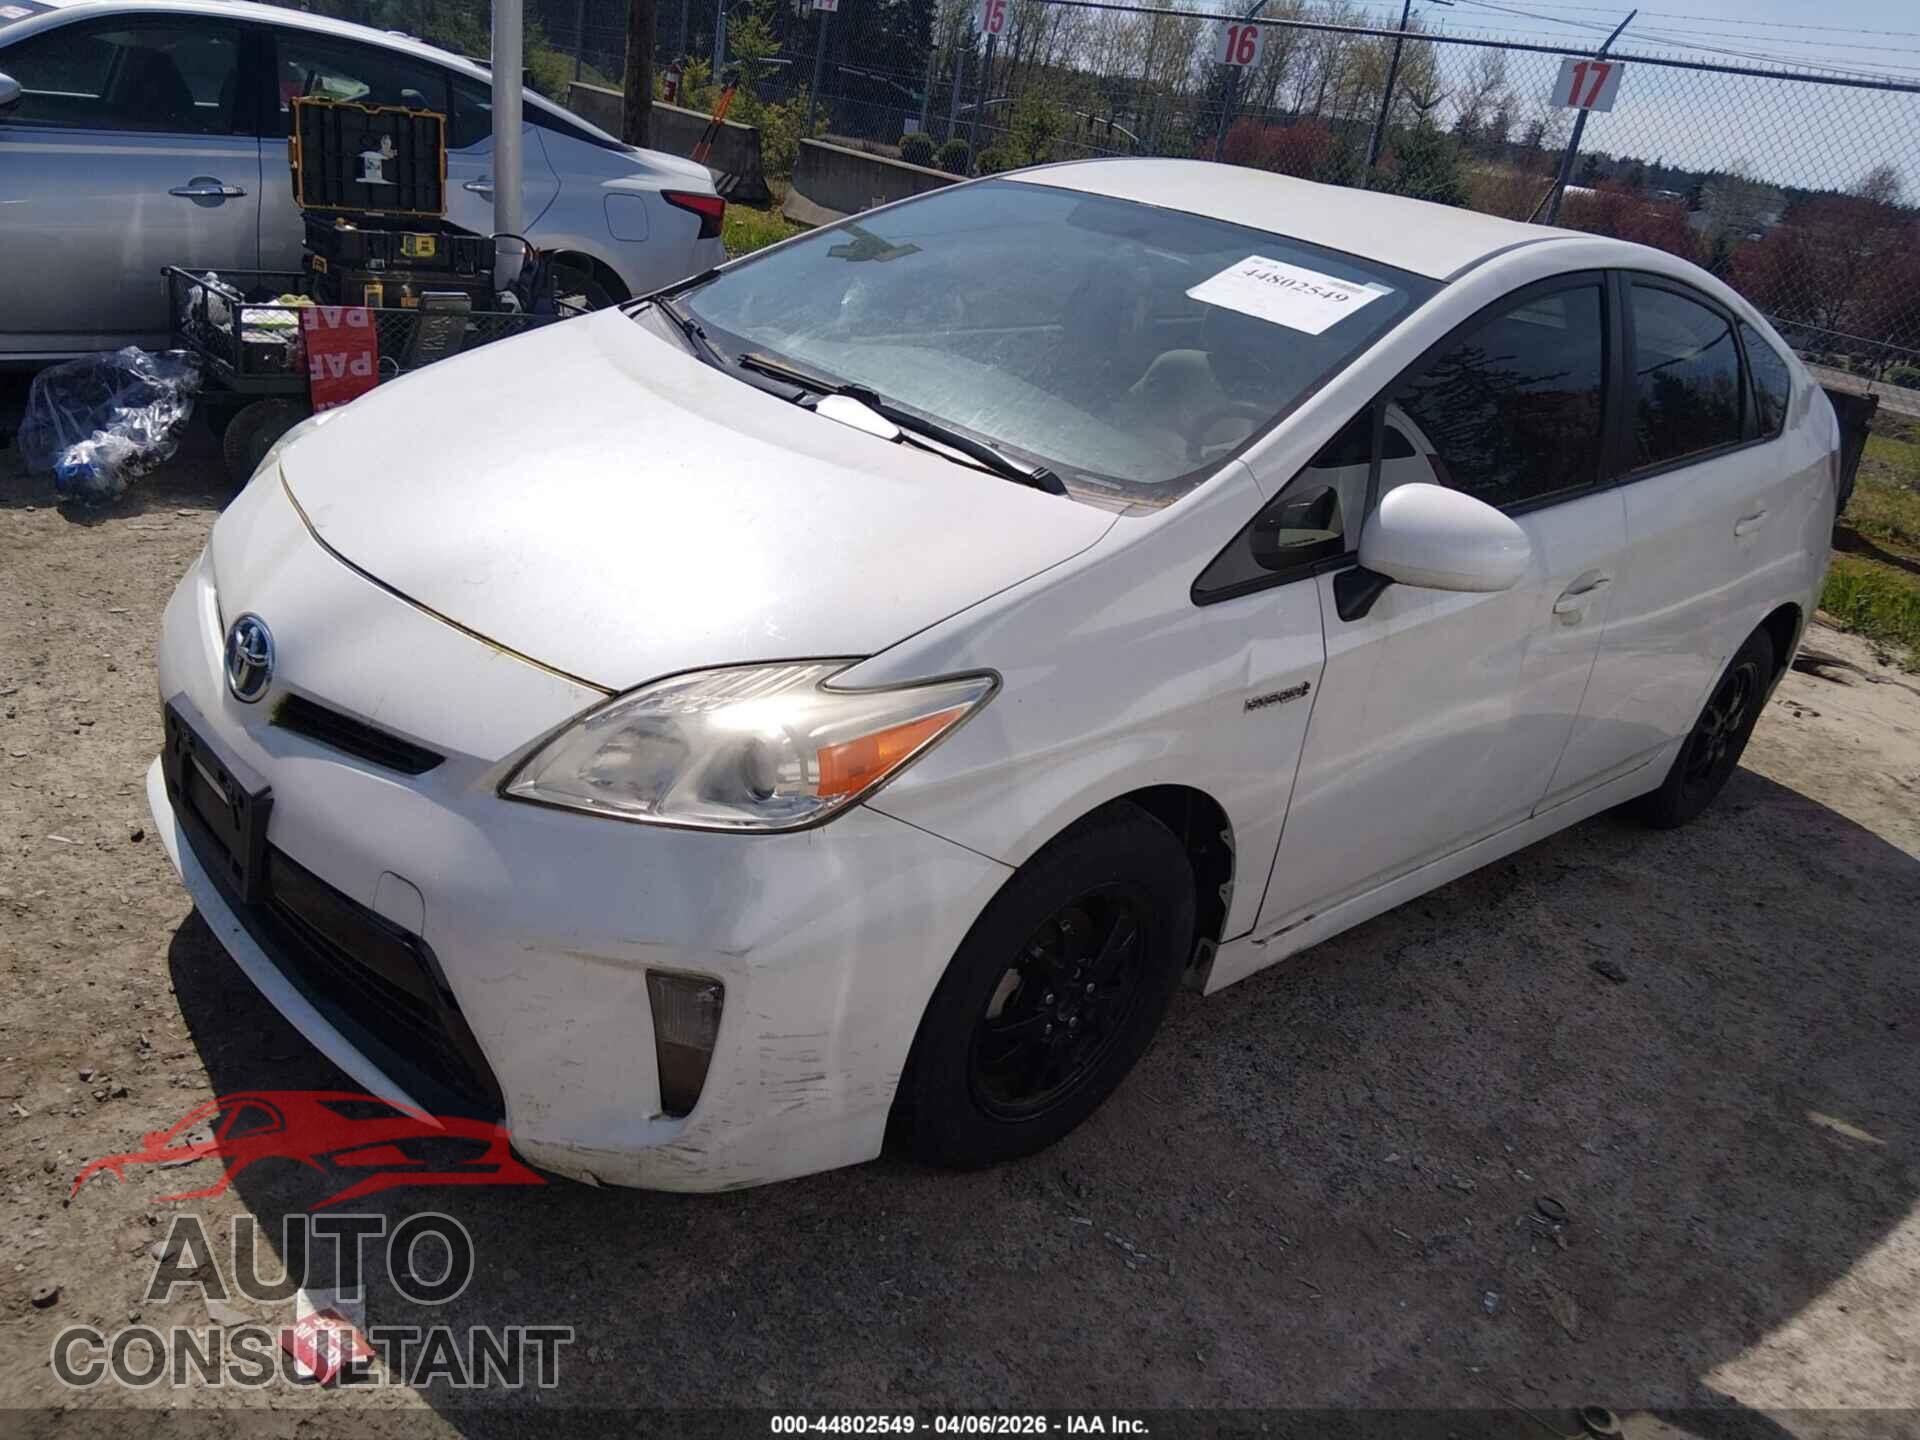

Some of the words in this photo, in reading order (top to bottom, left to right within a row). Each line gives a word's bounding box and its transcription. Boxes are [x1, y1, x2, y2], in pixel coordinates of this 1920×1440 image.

[983, 0, 1007, 33] 15
[1225, 25, 1258, 65] 16
[1568, 62, 1611, 107] 17
[1242, 268, 1350, 303] 44802549
